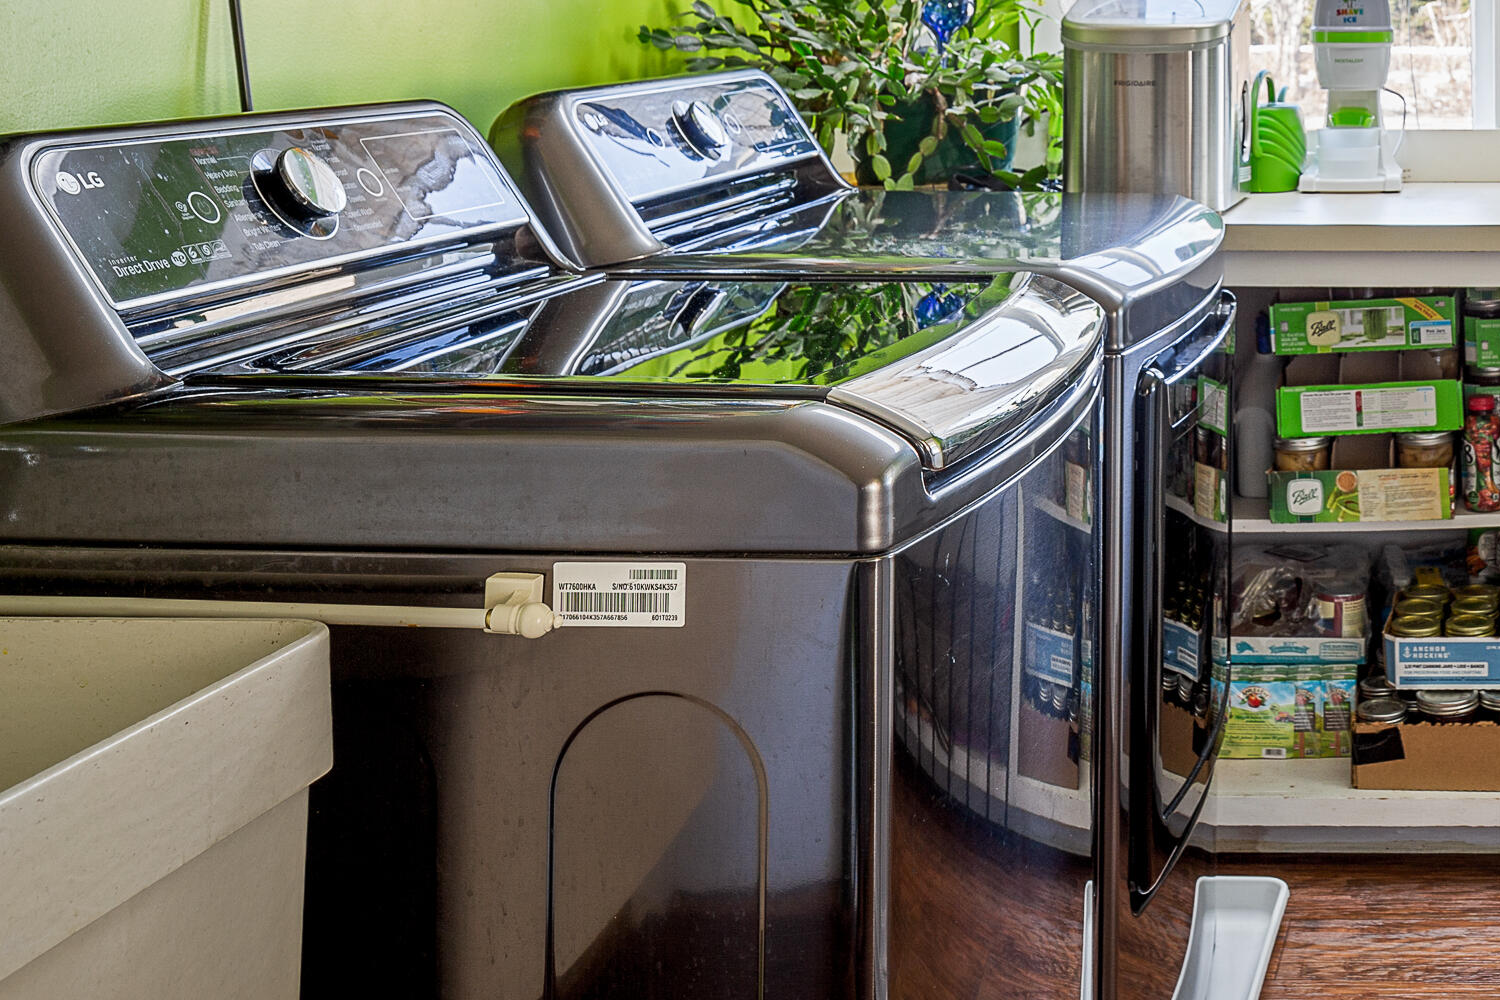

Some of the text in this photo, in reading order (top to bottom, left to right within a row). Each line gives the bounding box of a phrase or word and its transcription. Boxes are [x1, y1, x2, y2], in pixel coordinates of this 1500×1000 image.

[1336, 8, 1364, 16] SHAVE
[194, 155, 218, 165] Normal
[204, 169, 239, 180] Heavy Duty
[76, 171, 105, 190] LG
[214, 185, 240, 194] Bedding
[252, 242, 265, 250] Tub
[108, 255, 138, 266] Inverter
[112, 261, 144, 278] Direct
[147, 258, 171, 273] Drive
[1310, 319, 1337, 337] Ball
[1292, 488, 1319, 506] Ball
[558, 583, 597, 591] WT7600HKA
